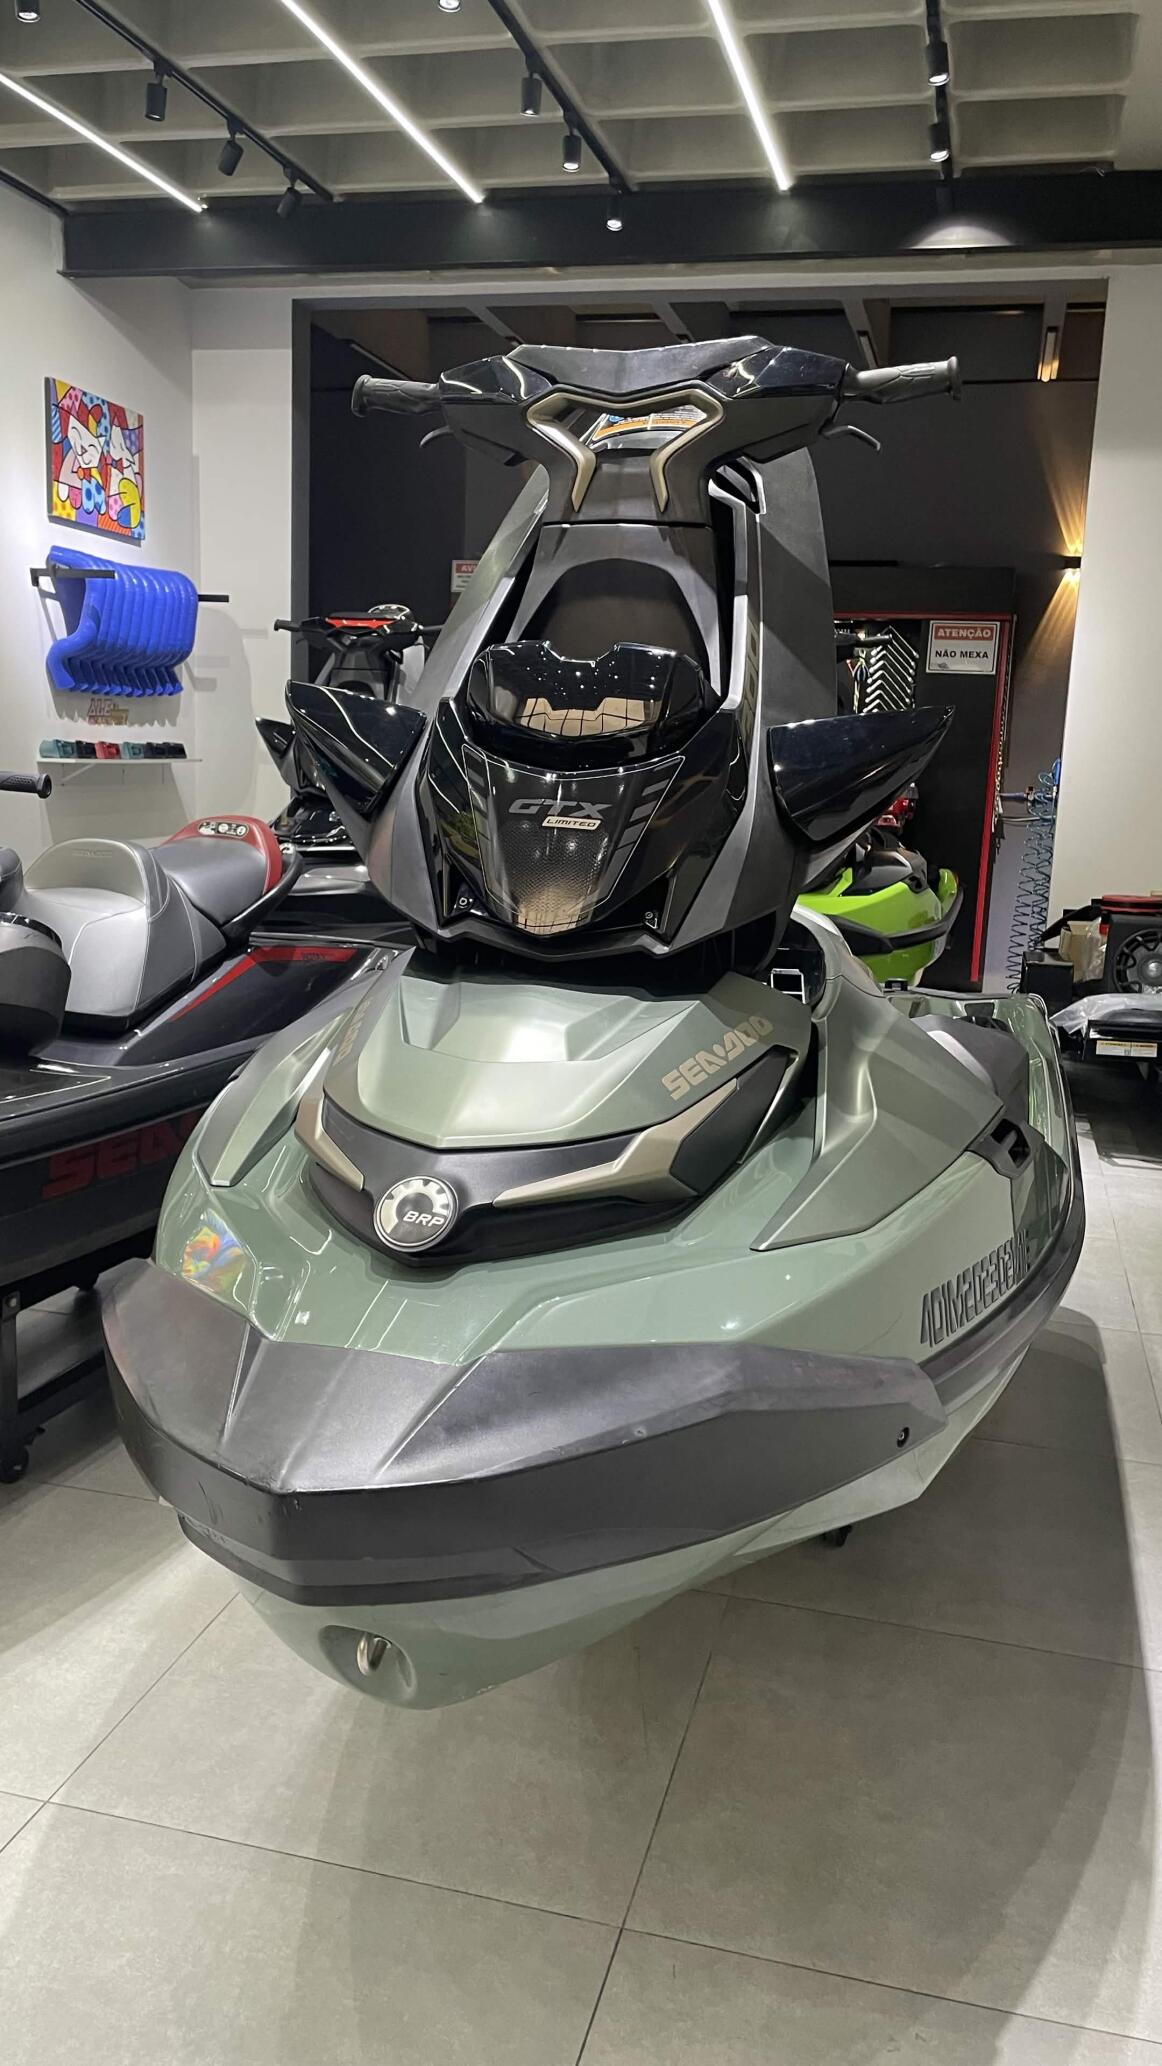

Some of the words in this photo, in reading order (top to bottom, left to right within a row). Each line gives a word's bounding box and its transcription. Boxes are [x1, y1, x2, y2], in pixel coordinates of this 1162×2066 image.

[937, 628, 991, 639] ATENÇÃO
[935, 649, 957, 658] NÃO
[960, 651, 989, 659] MEXA
[508, 798, 613, 820] GTX
[546, 818, 597, 829] LIMITED
[402, 1210, 445, 1227] BRP
